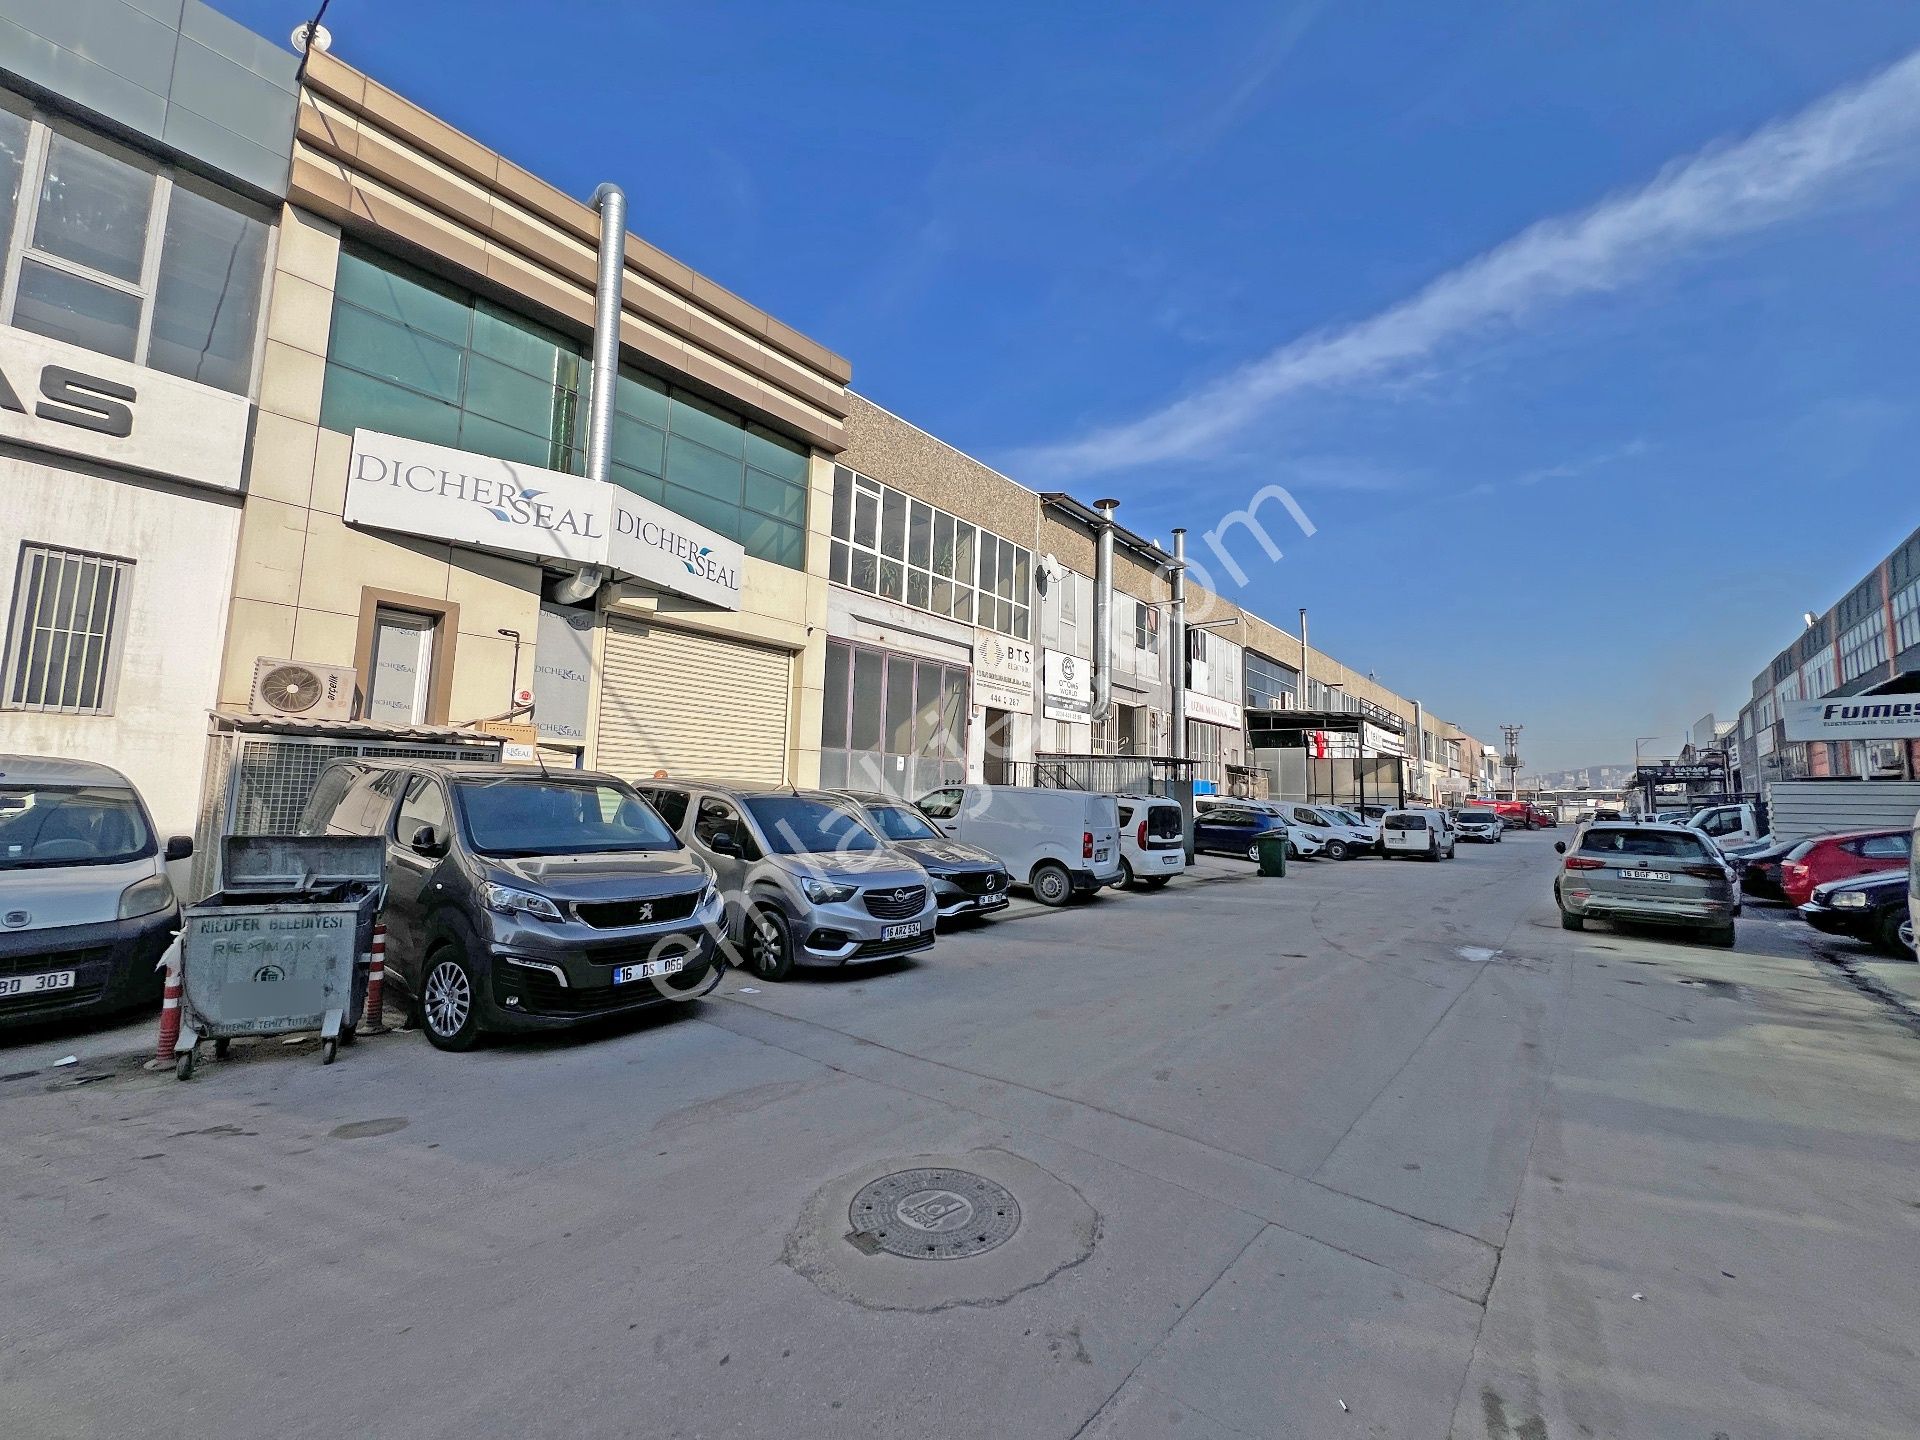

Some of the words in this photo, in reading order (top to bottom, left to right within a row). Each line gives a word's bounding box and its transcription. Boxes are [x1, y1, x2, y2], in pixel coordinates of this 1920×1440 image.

[886, 926, 894, 938] 16
[895, 924, 907, 937] ARZ
[620, 967, 633, 983] 16
[642, 963, 655, 978] DS
[664, 957, 682, 973] 066
[35, 973, 70, 990] 303
